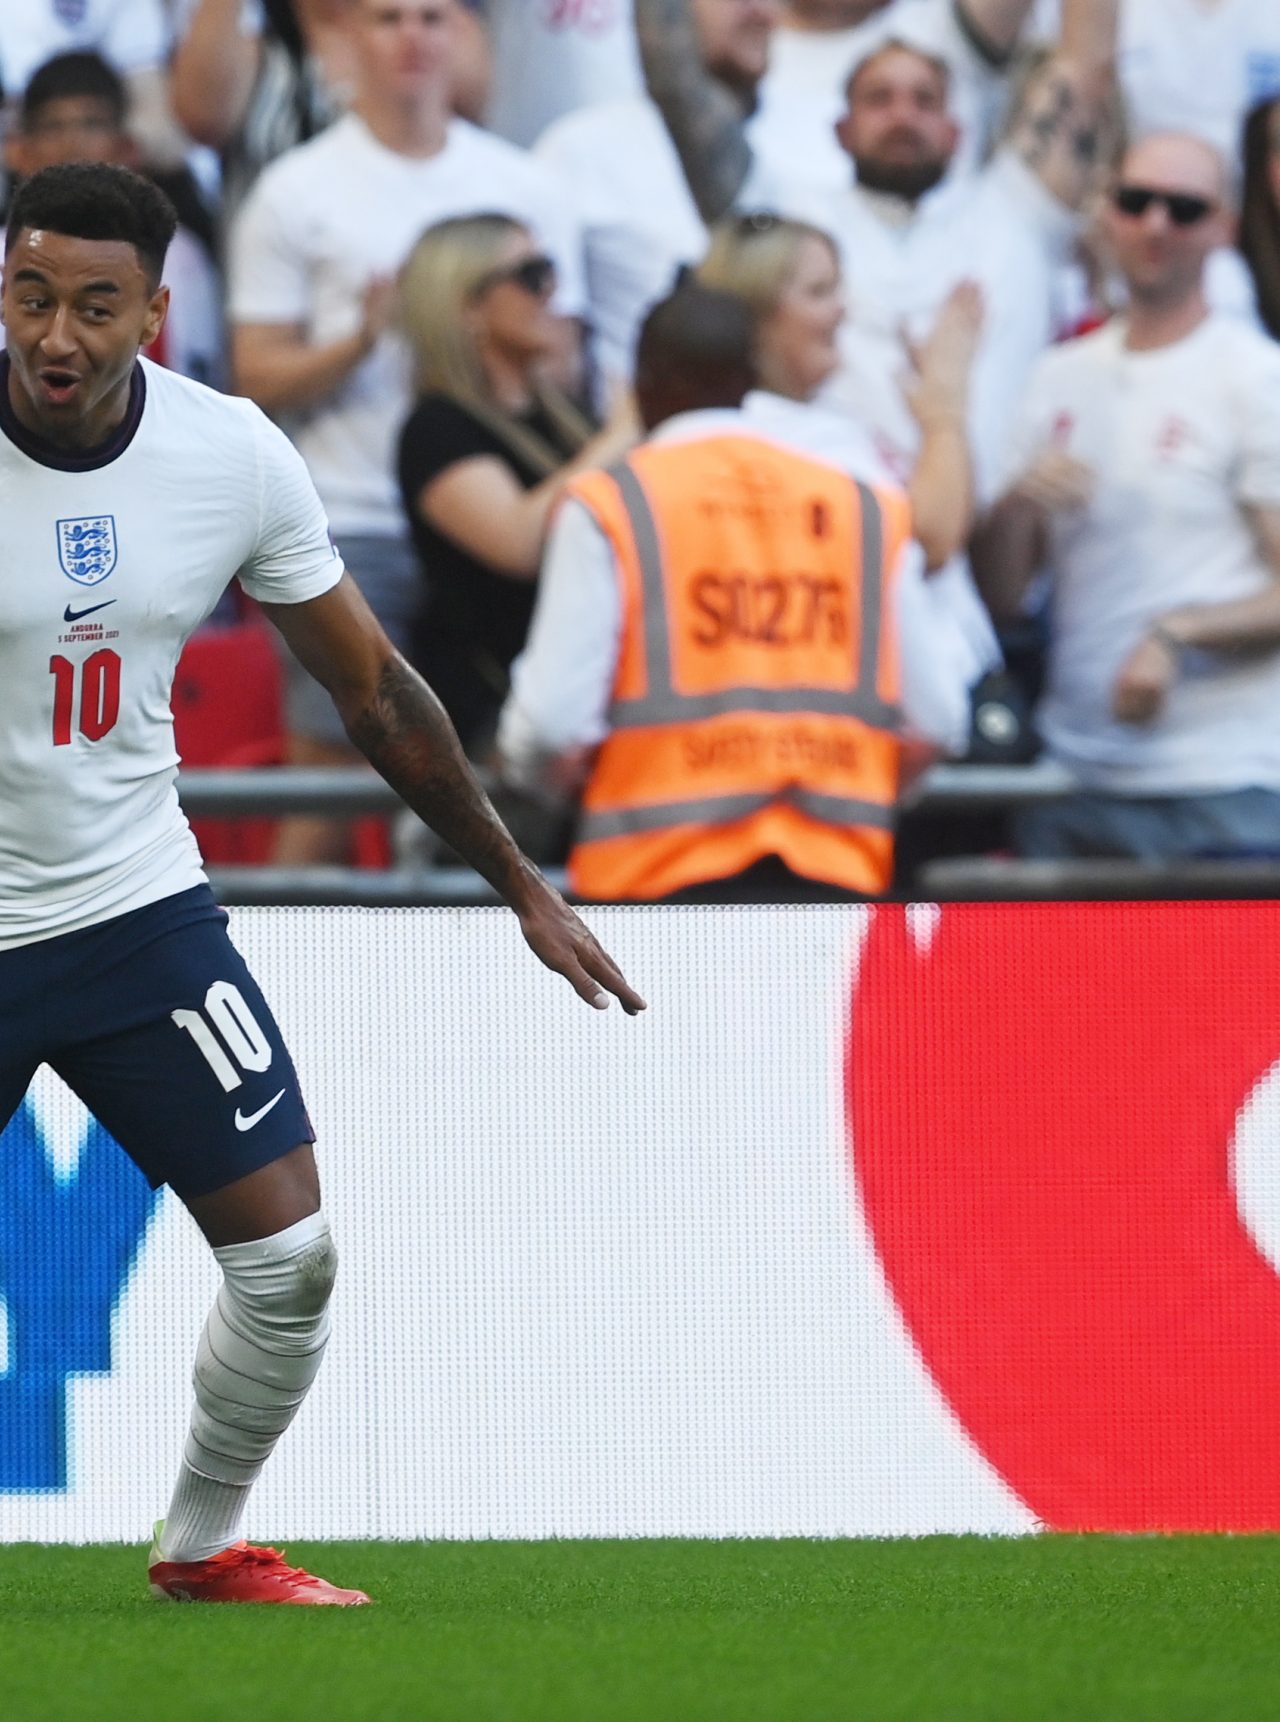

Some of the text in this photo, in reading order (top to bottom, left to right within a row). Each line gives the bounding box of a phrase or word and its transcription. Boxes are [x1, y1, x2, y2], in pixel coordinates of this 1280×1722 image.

[64, 632, 103, 642] SEPTEMBER
[71, 623, 104, 632] ANDORRA
[49, 648, 121, 746] 10
[170, 980, 272, 1093] 10
